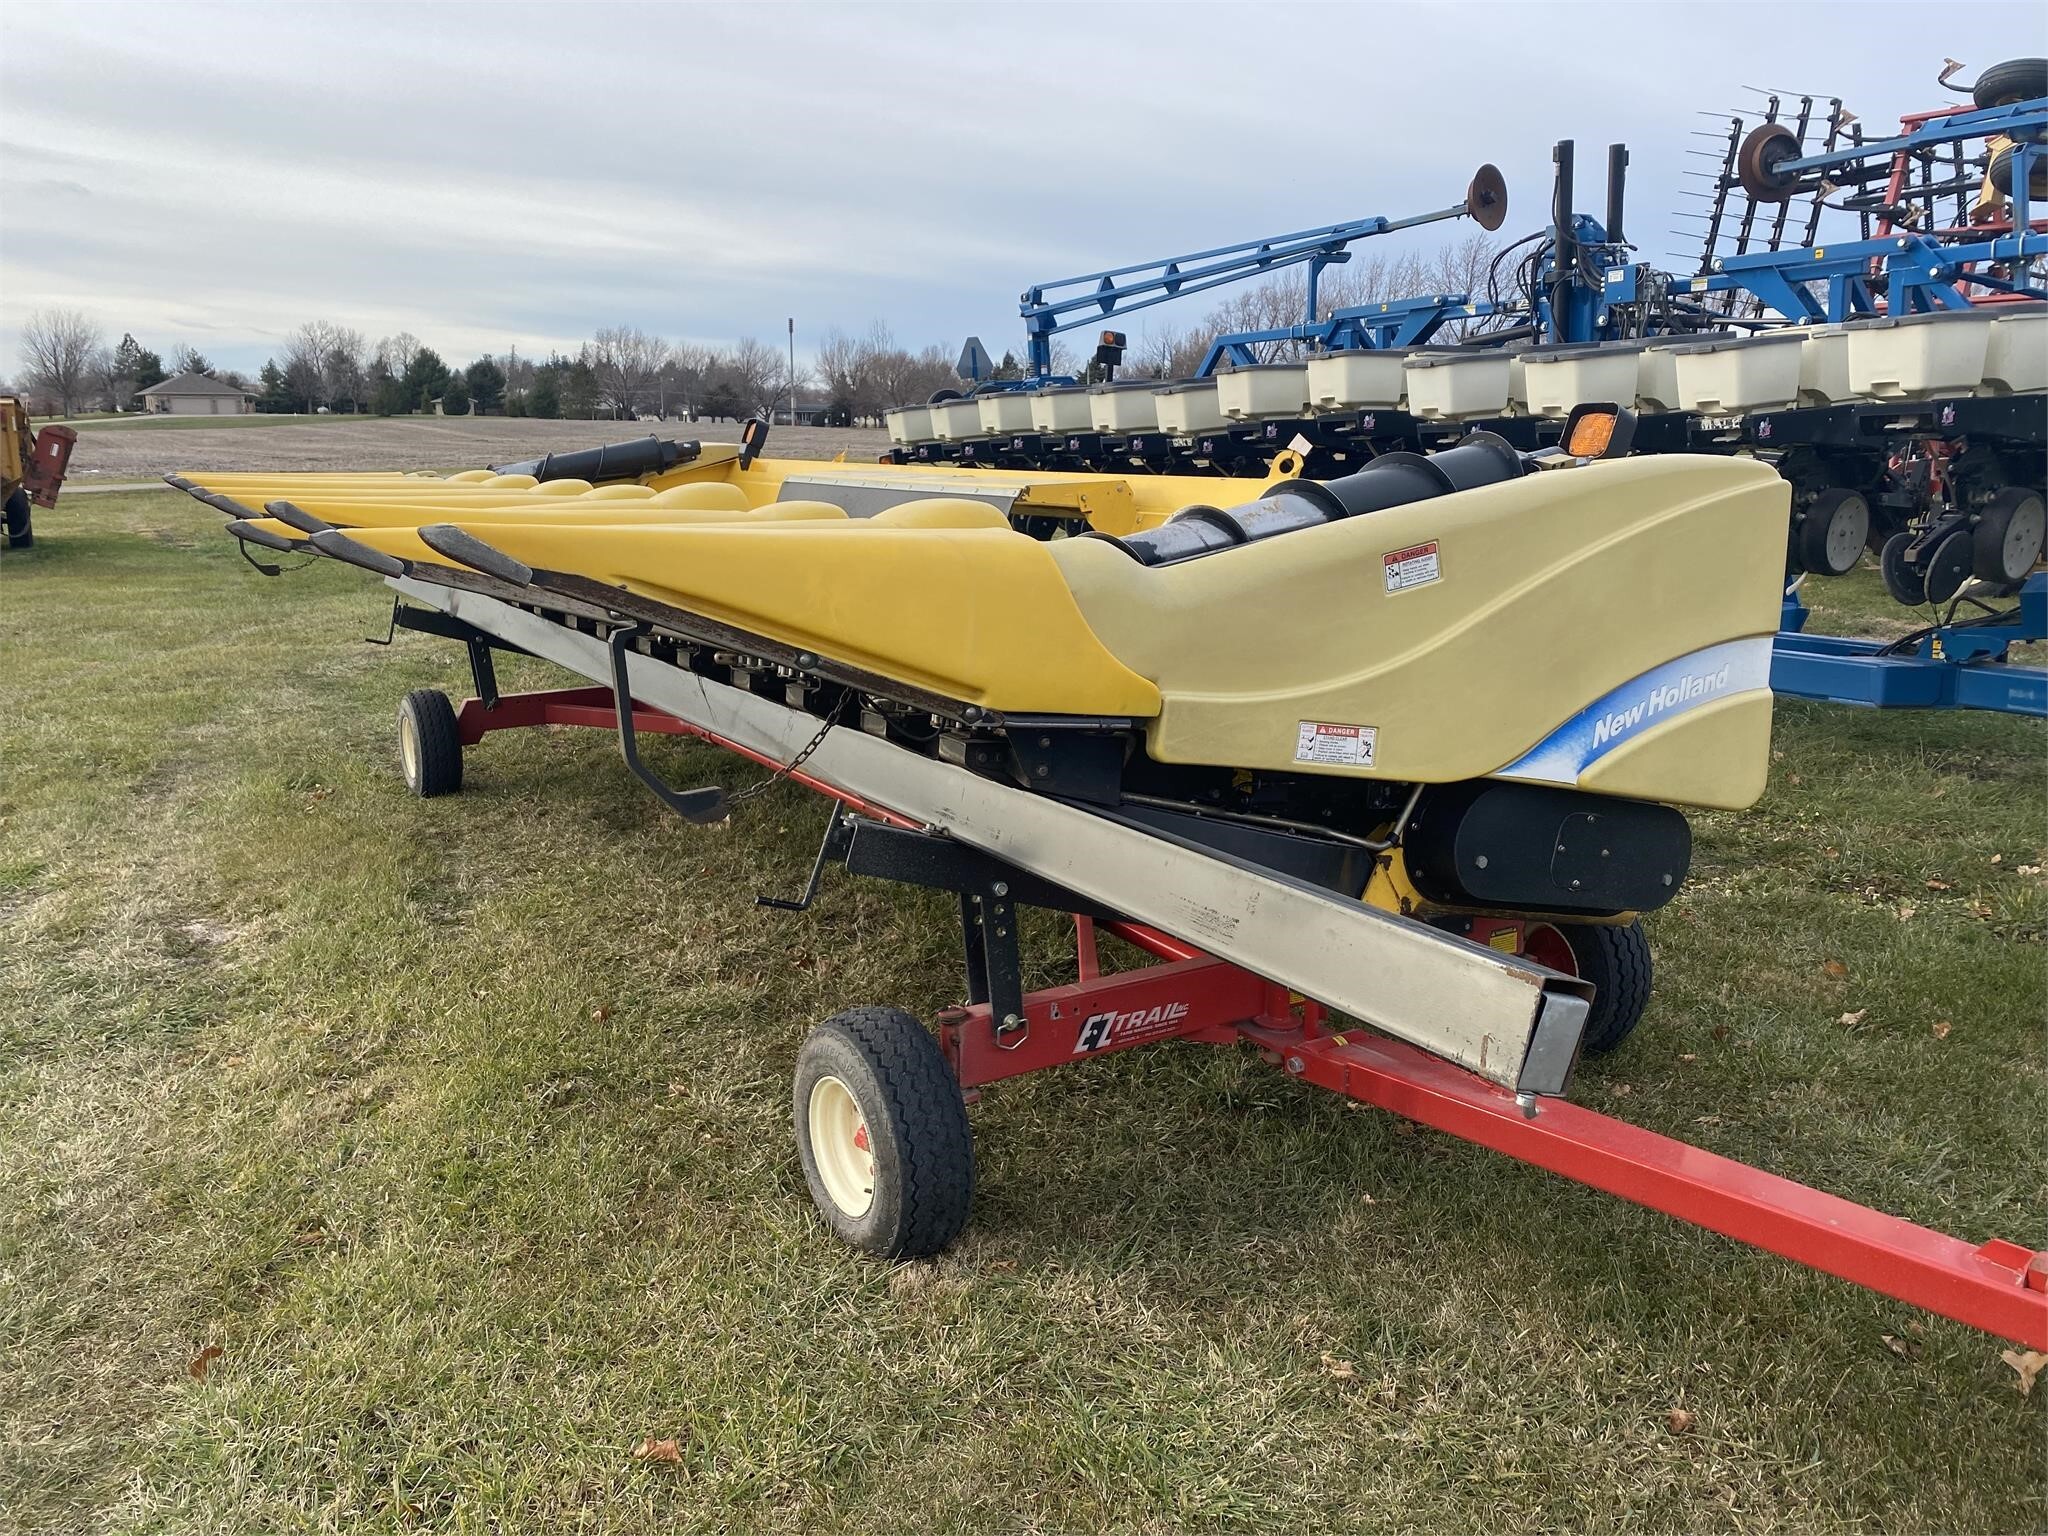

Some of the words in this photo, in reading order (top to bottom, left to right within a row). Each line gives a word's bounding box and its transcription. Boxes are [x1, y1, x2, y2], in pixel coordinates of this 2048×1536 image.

[1402, 547, 1428, 559] DANGER
[1593, 701, 1646, 749] New
[1648, 664, 1729, 717] Holland
[1328, 727, 1355, 735] DANGER
[1115, 1003, 1188, 1032] TRAIL
